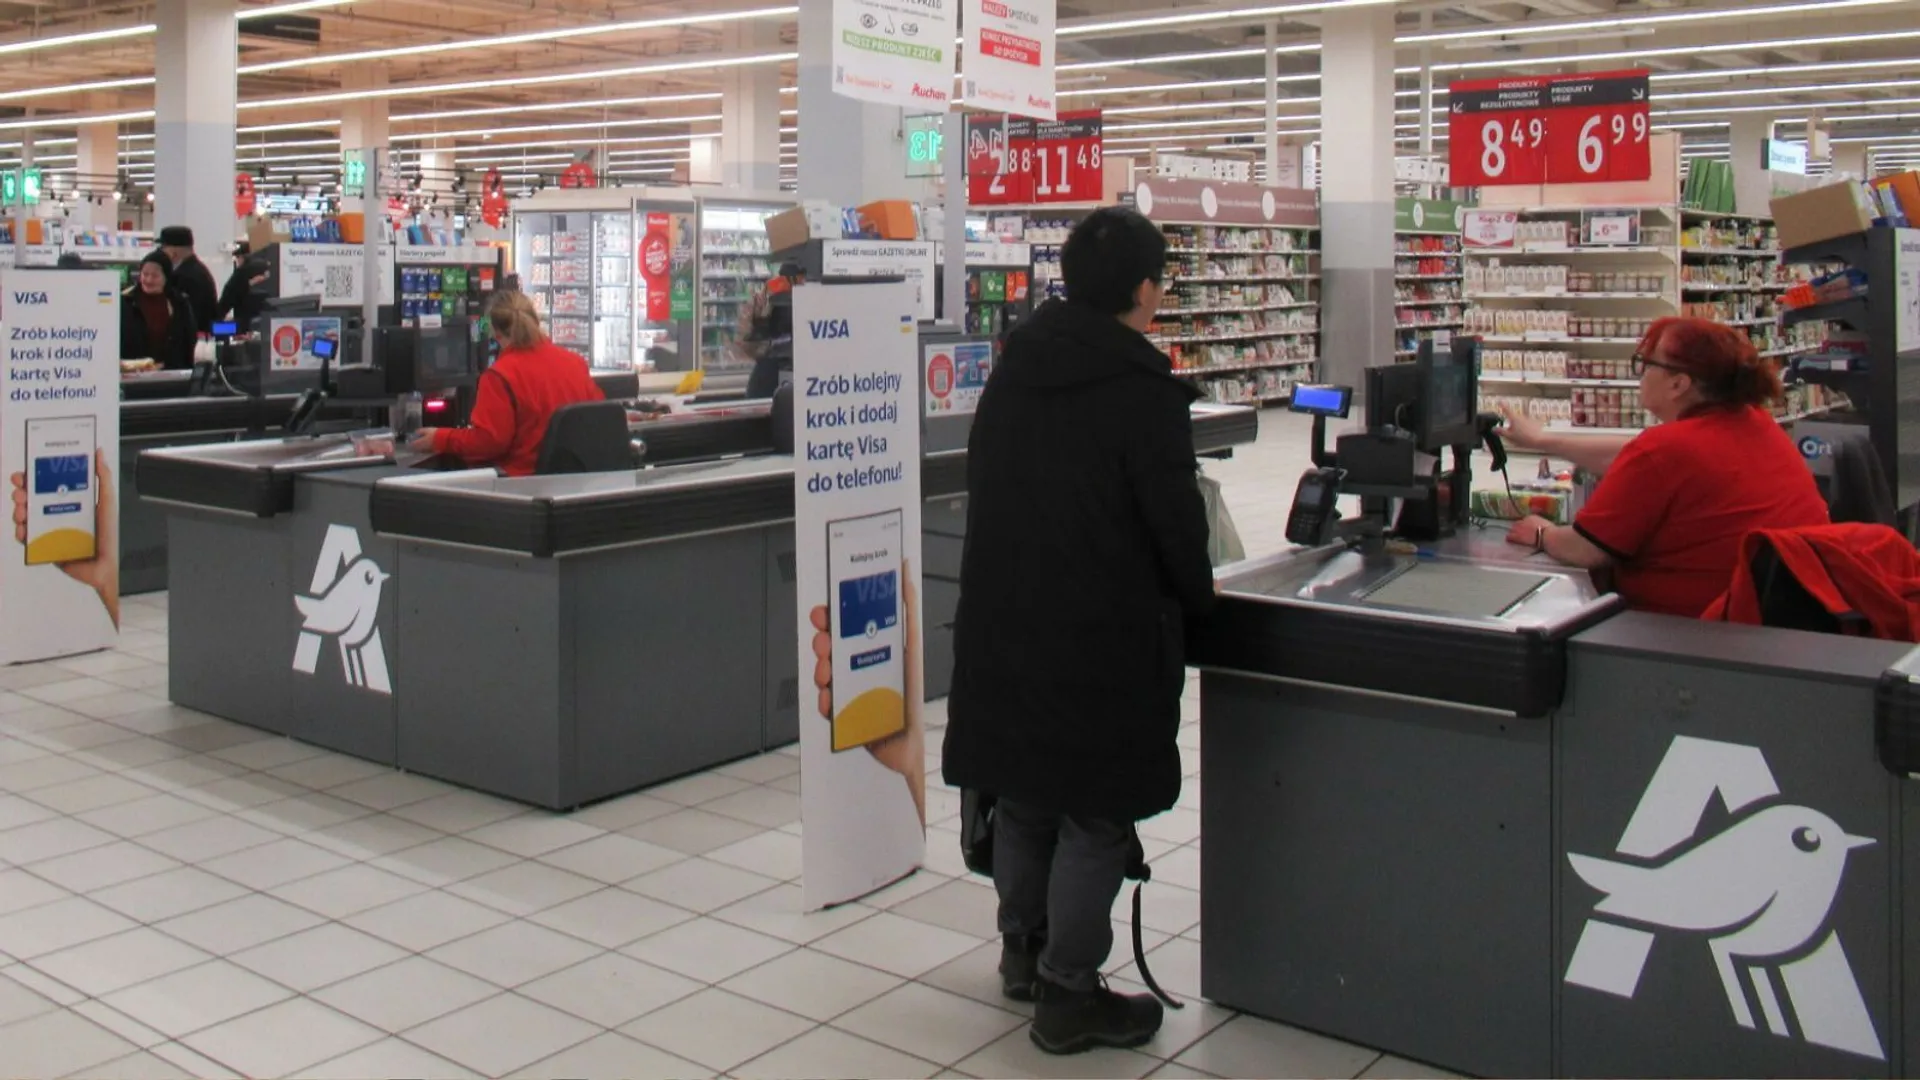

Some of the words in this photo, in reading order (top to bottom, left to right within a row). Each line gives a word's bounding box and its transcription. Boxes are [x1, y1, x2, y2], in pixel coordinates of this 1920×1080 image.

[912, 83, 946, 100] Auchan
[1498, 90, 1541, 99] PRODUKTY
[1551, 84, 1594, 94] PRODUKTY
[1481, 119, 1506, 177] 8
[1510, 117, 1542, 148] 49
[1577, 114, 1603, 174] 6
[1611, 111, 1646, 145] 99
[1009, 148, 1031, 173] 88
[1037, 146, 1071, 194] 11
[1076, 144, 1101, 170] 48
[14, 291, 49, 305] VISA
[10, 327, 48, 341] Zrób
[51, 326, 98, 342] kolejny
[809, 319, 849, 339] VISA
[10, 347, 44, 361] krok
[54, 345, 93, 362] dodaj
[10, 368, 51, 383] kartę
[54, 366, 82, 380] Visa
[806, 374, 850, 397] Zrób
[853, 370, 901, 395] kolejny
[10, 388, 31, 401] do
[34, 385, 96, 401] telefonu!
[806, 406, 847, 429] krok
[858, 400, 897, 424] dodaj
[806, 440, 854, 462] kartę
[857, 434, 887, 455] Visa
[807, 472, 833, 494] do
[836, 460, 902, 490] telefonu!
